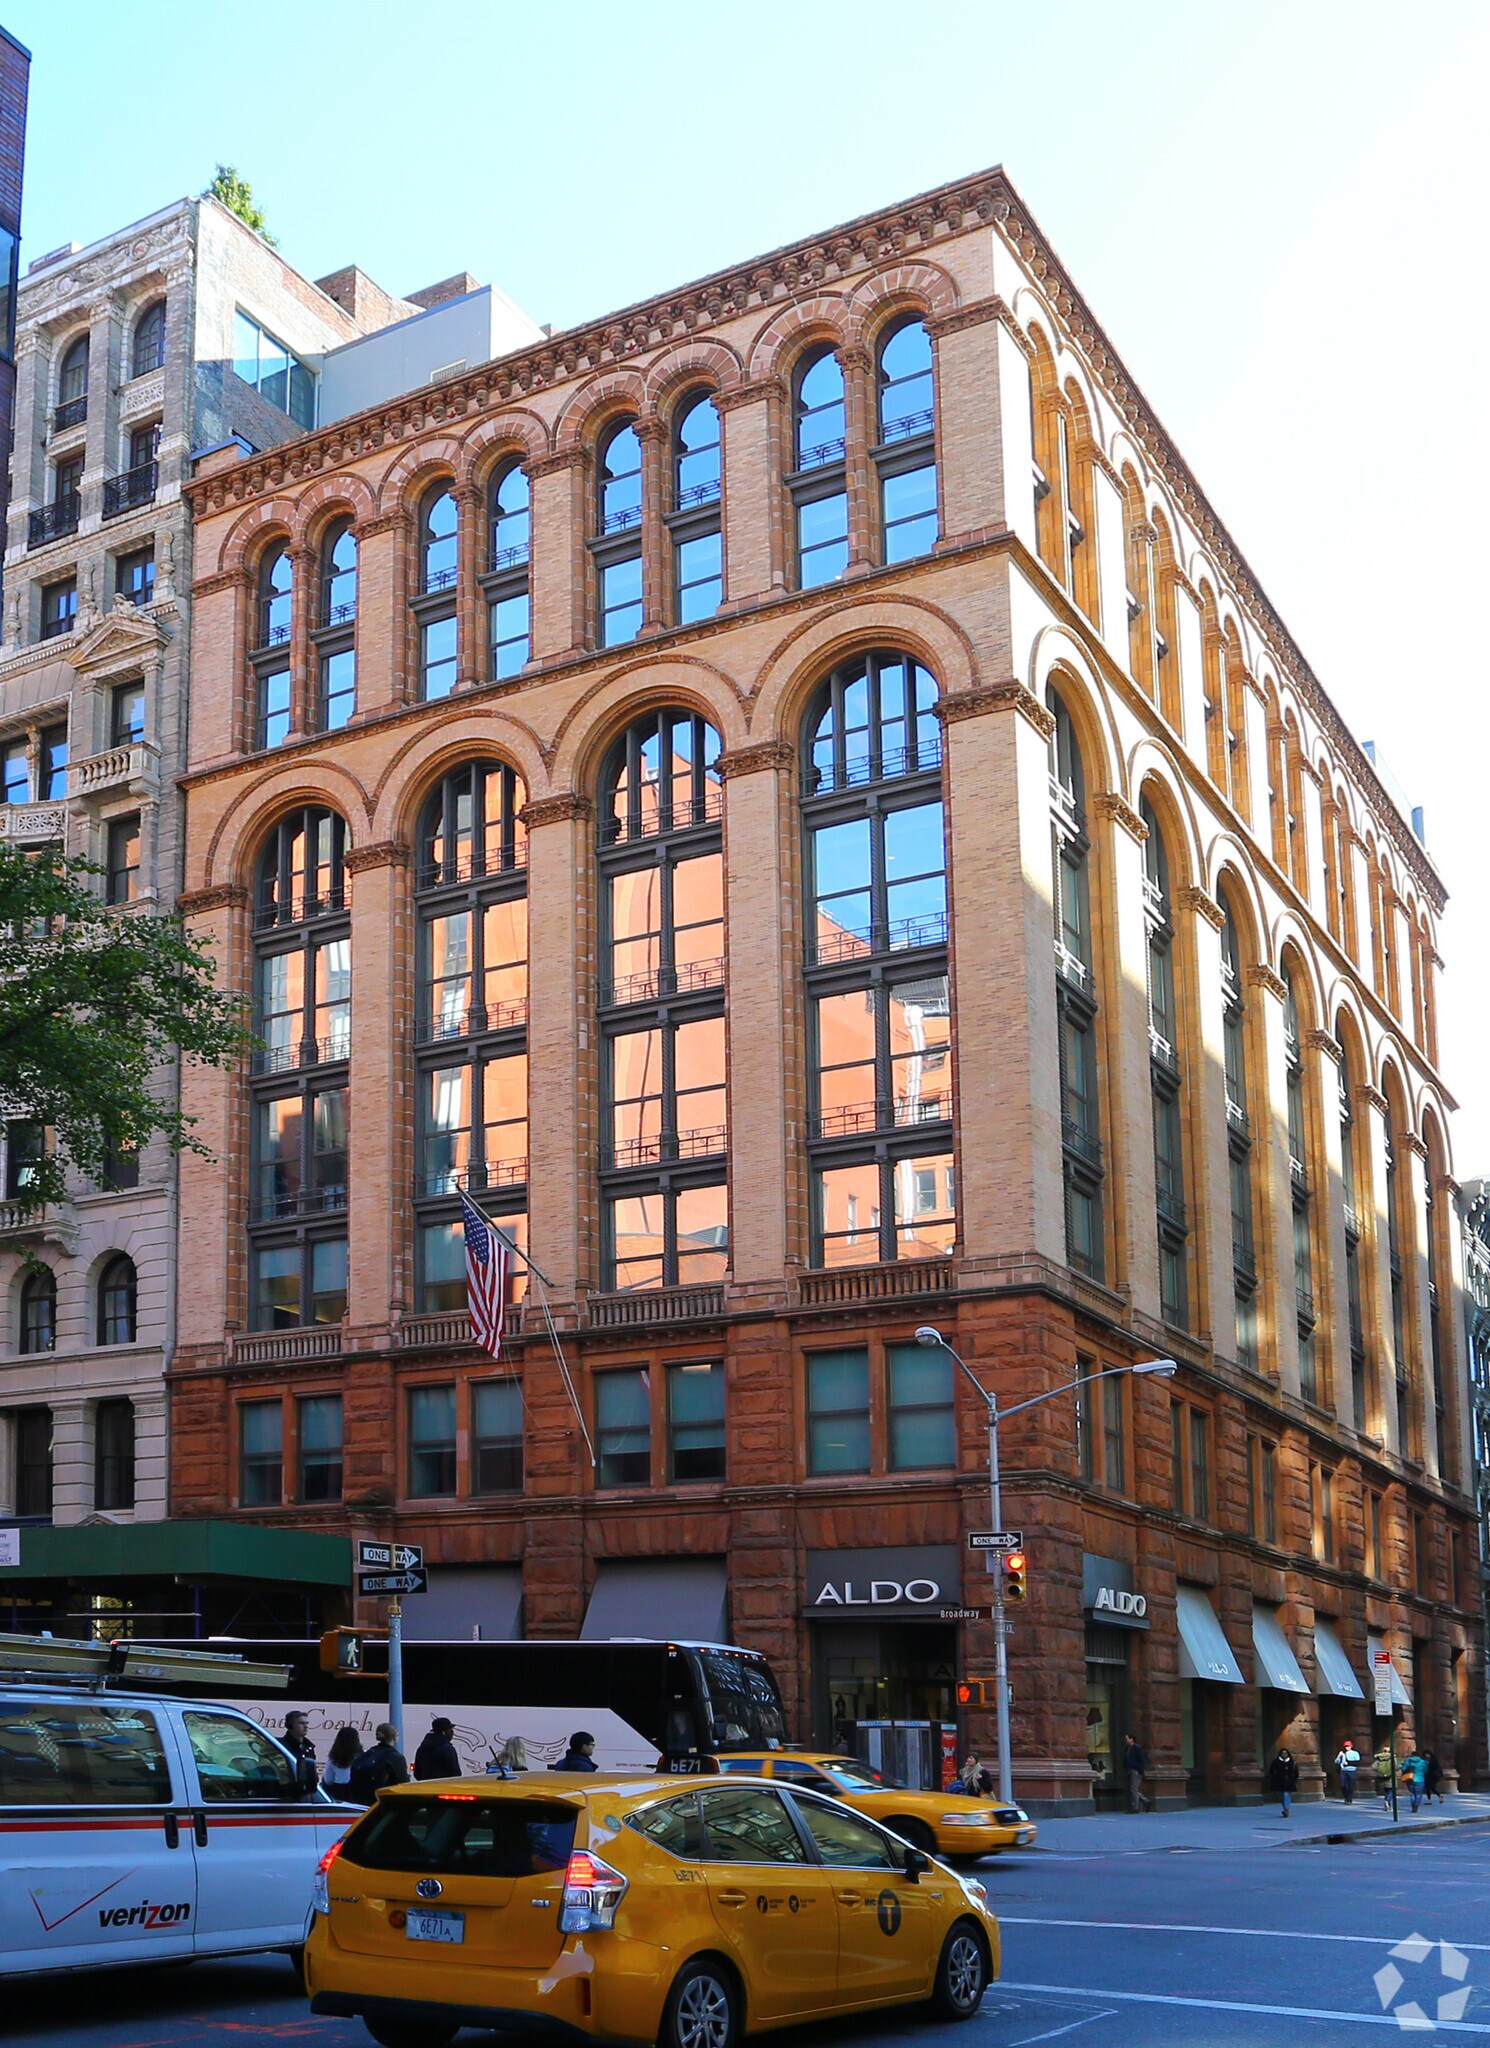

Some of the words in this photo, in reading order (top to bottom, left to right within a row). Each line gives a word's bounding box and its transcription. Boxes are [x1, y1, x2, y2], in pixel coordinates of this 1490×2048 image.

[368, 1549, 387, 1561] ONE
[395, 1552, 413, 1563] WAY
[367, 1578, 387, 1589] ONE
[395, 1576, 416, 1587] WAY
[815, 1579, 940, 1605] ALDO
[940, 1609, 980, 1619] Broadway
[1094, 1587, 1147, 1617] ALDO
[306, 1708, 374, 1732] Coach
[98, 1899, 191, 1930] verizon
